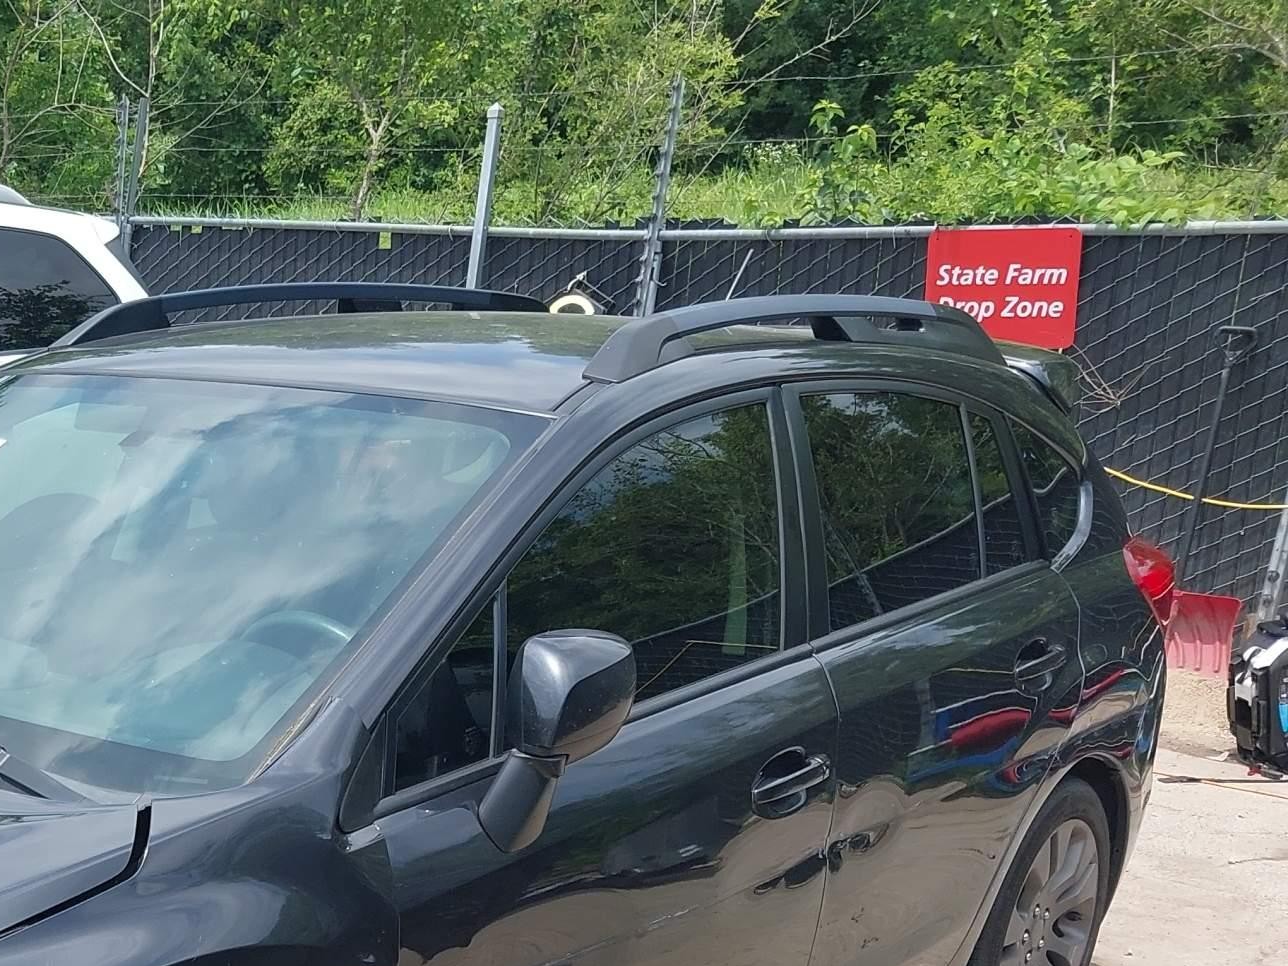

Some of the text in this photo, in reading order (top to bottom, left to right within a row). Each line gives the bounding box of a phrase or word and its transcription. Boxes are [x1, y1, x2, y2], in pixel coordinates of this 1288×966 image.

[936, 263, 1068, 286] State Farm
[1000, 296, 1064, 318] Zone
